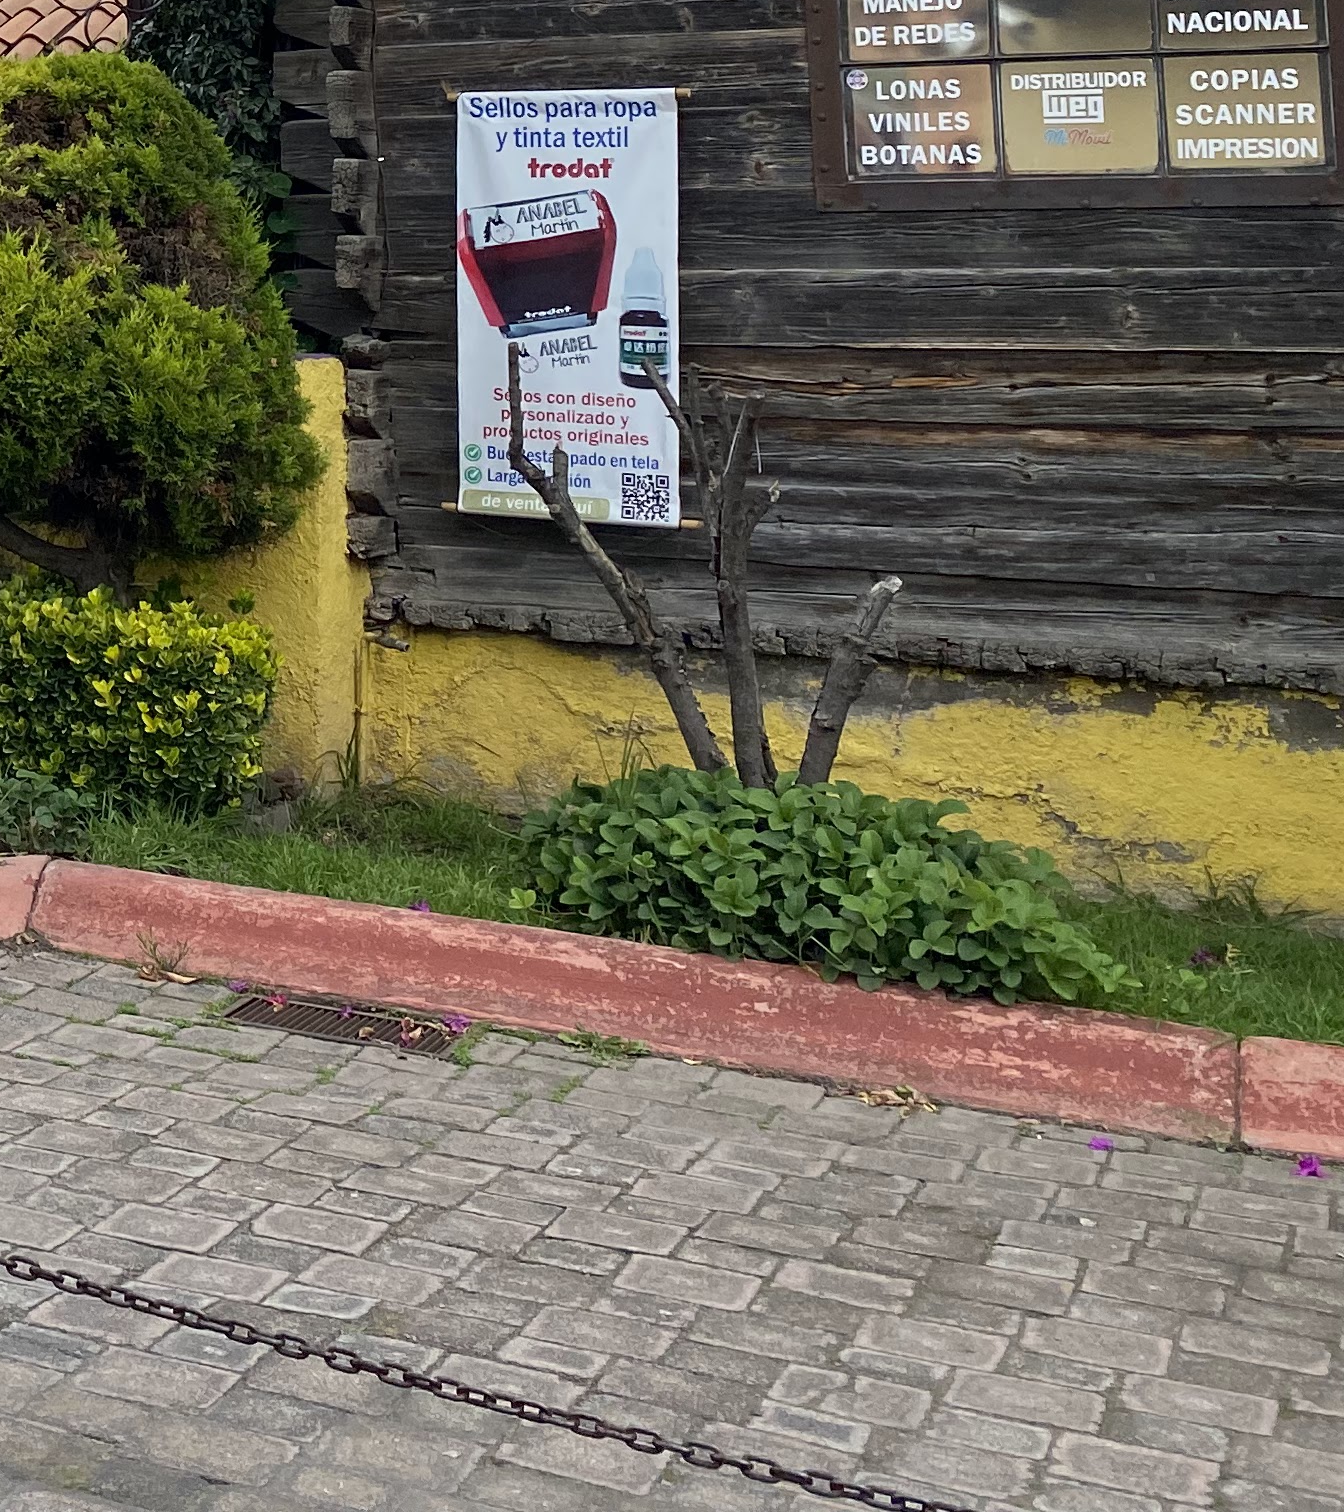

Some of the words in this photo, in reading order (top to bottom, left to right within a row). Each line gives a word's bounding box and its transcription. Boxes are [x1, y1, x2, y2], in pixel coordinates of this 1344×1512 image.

[1167, 8, 1309, 34] NACIONAL
[854, 25, 887, 47] DE
[894, 22, 976, 45] REDES
[875, 79, 961, 101] LONAS
[1010, 71, 1147, 90] DISTRIBUIDOR
[1189, 68, 1299, 91] COPIAS
[469, 97, 539, 118] Sellos
[545, 101, 597, 122] para
[604, 100, 657, 122] ropa
[1175, 102, 1316, 126] SCANNER
[868, 112, 970, 134] VINILES
[495, 130, 508, 152] y
[514, 127, 566, 148] tinta
[573, 126, 629, 148] textil
[1177, 136, 1319, 160] IMPRESION
[861, 144, 982, 166] BOTANAS
[527, 157, 614, 179] trodat
[516, 197, 588, 224] ANABEL
[523, 305, 572, 319] trodat
[539, 334, 598, 357] ANABEL
[493, 387, 542, 404] Seos
[547, 393, 576, 405] con
[581, 392, 636, 409] diseño
[501, 408, 615, 426] prsonalizado
[620, 415, 629, 429] y
[483, 425, 562, 442] prouctos
[567, 429, 650, 446] originales
[528, 451, 606, 467] estapado
[611, 456, 627, 468] en
[632, 454, 659, 470] tela
[487, 468, 525, 487] Larga
[481, 494, 502, 507] de
